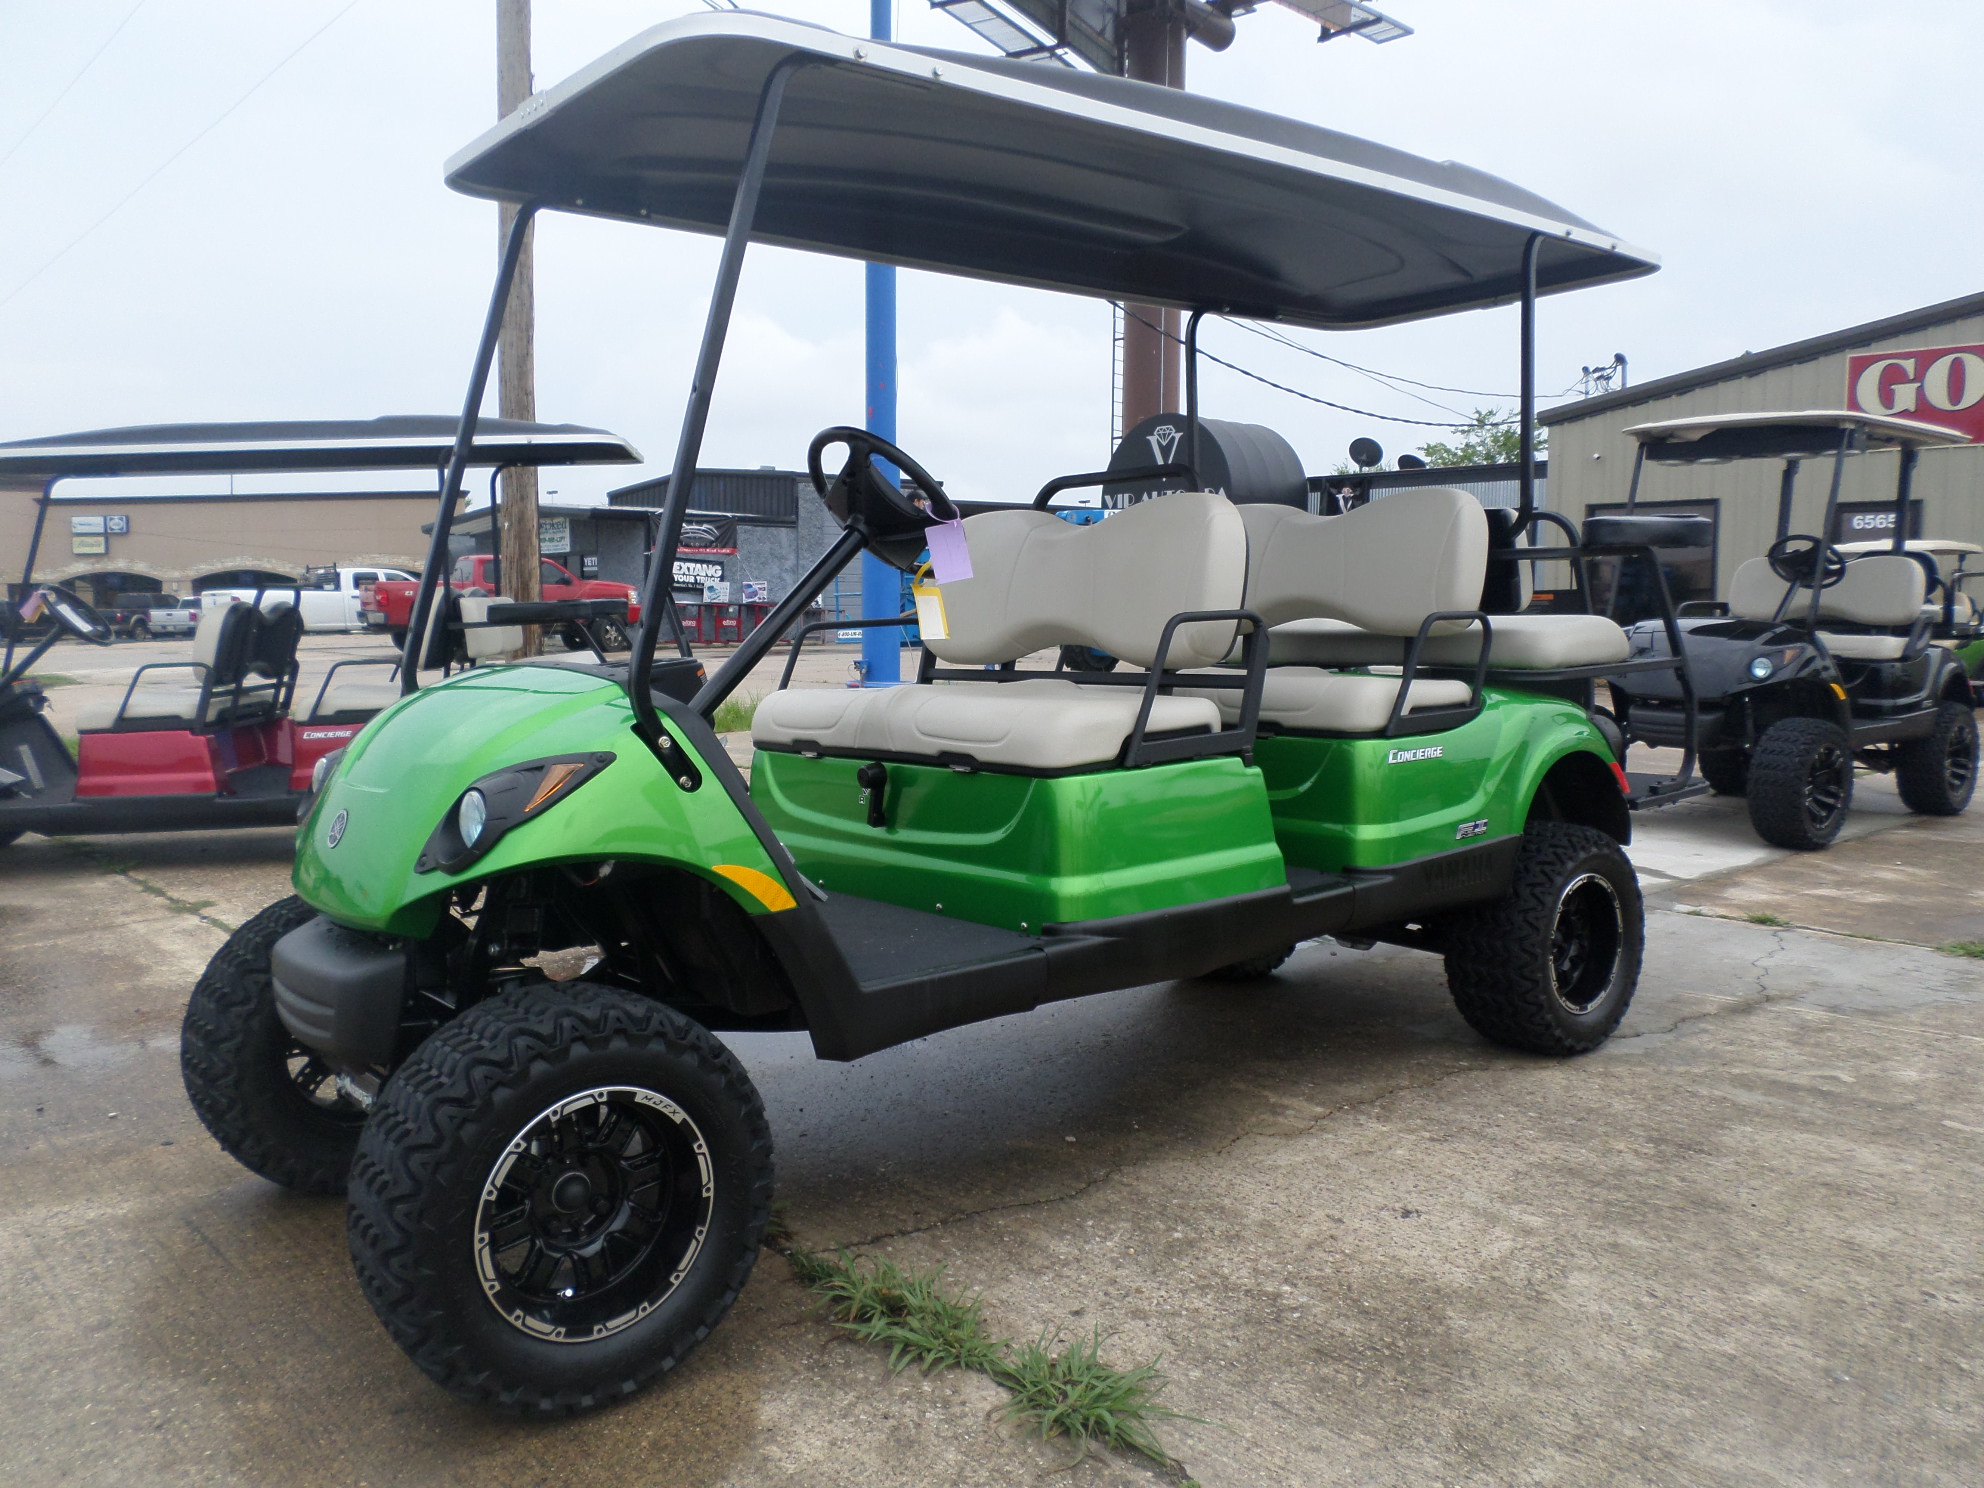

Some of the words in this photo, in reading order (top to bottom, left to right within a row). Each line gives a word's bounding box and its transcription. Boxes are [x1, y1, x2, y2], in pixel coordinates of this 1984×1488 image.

[1856, 352, 1984, 416] GO
[1104, 493, 1135, 510] VIP
[1853, 514, 1896, 529] 6565
[583, 557, 598, 566] YETI
[672, 561, 723, 577] EXTANG
[673, 574, 696, 583] YOUR
[697, 576, 720, 584] TRUCK
